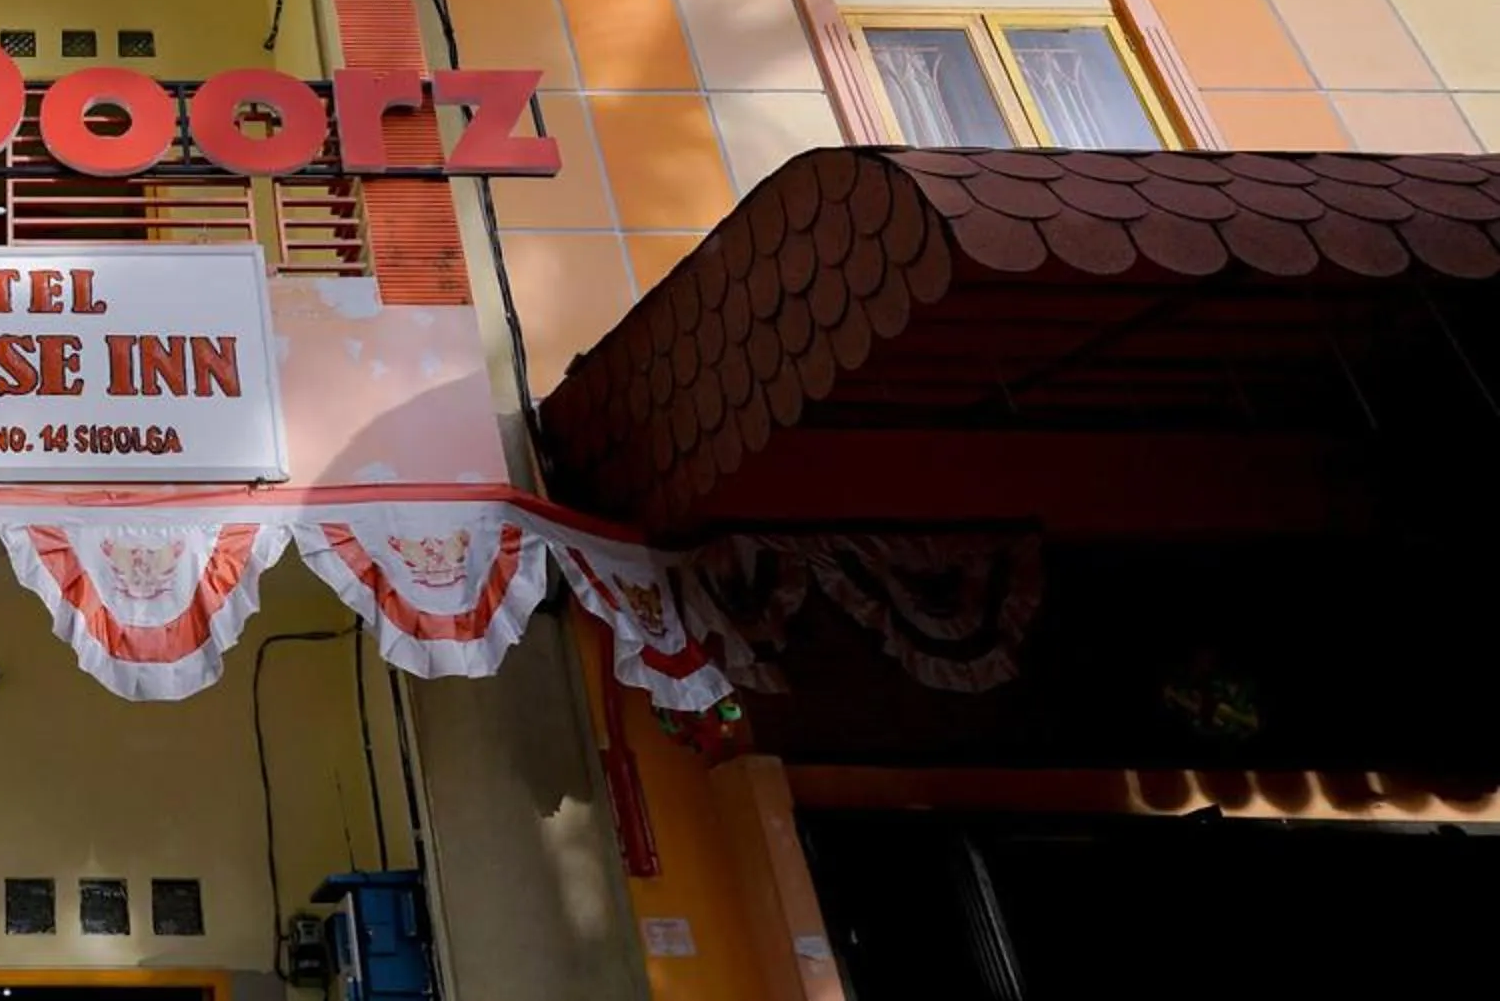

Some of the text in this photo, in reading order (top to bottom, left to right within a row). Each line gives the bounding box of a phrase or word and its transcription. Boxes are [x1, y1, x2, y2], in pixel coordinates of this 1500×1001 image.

[105, 334, 242, 398] INN
[39, 424, 69, 452] 14
[74, 424, 183, 454] SIBOLGA
